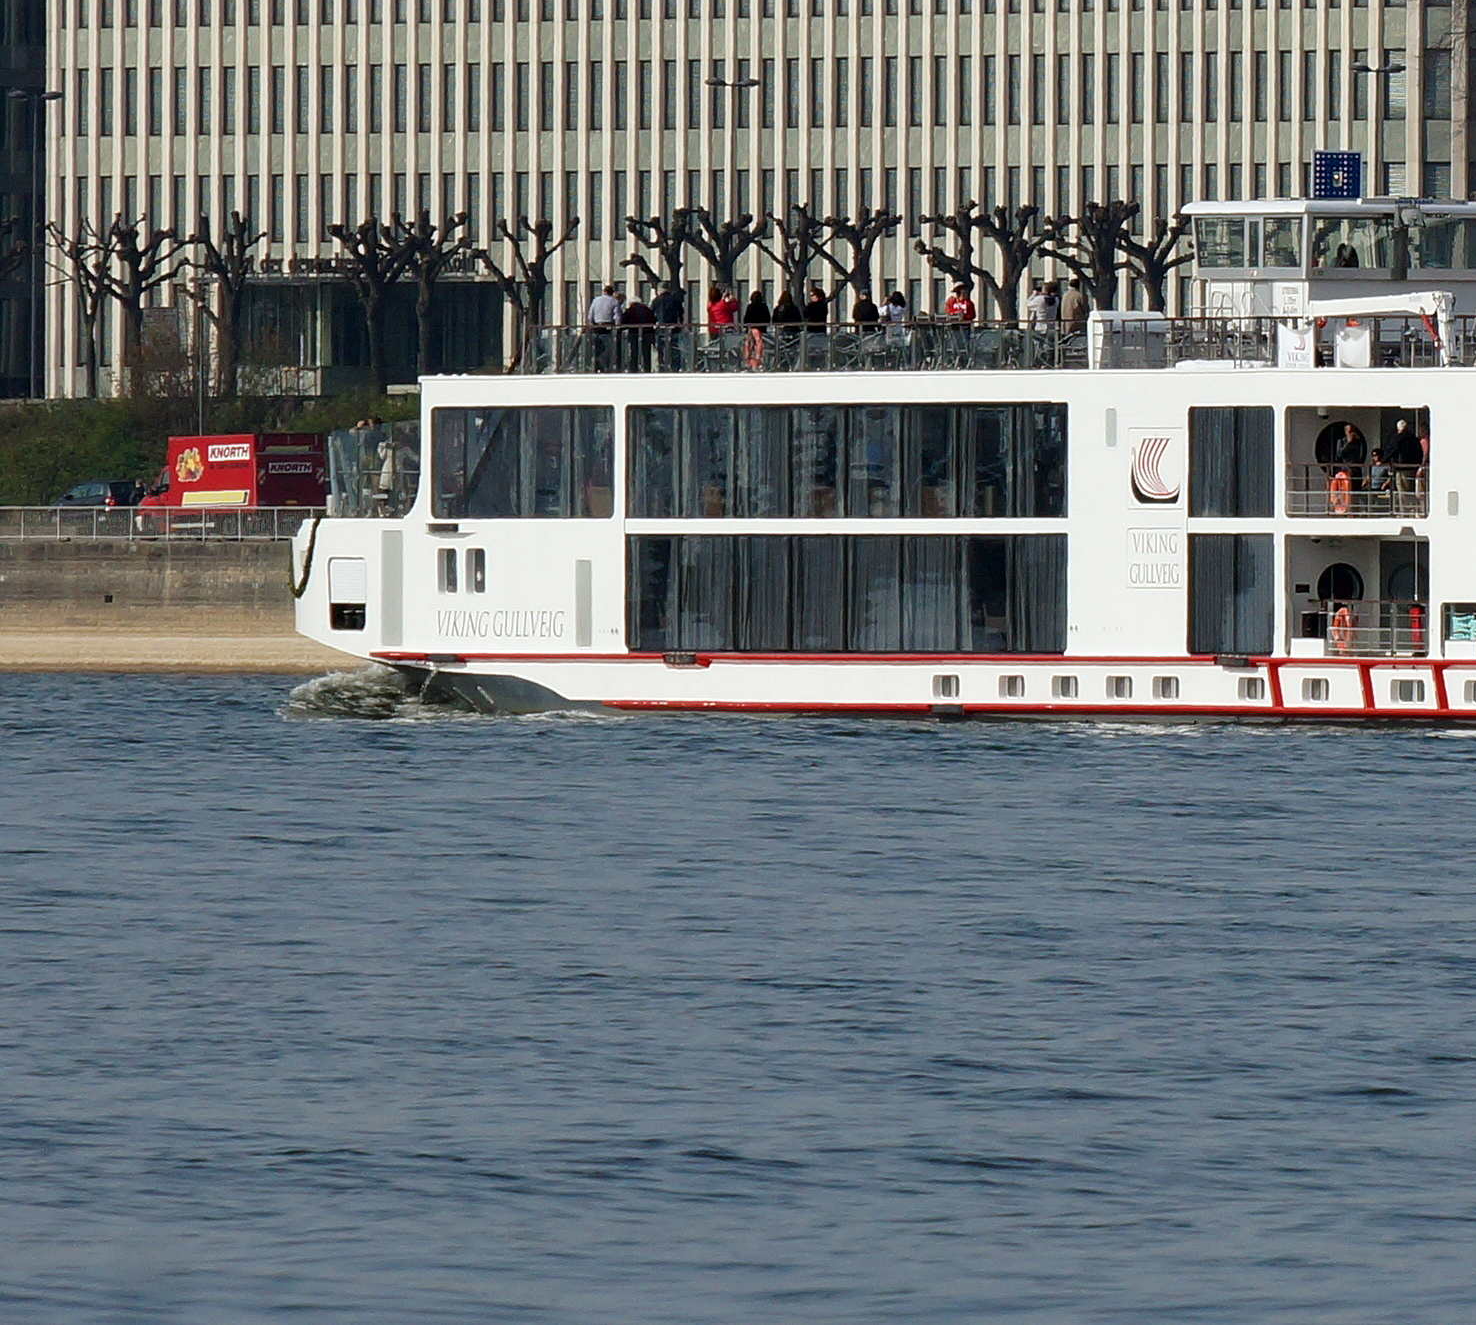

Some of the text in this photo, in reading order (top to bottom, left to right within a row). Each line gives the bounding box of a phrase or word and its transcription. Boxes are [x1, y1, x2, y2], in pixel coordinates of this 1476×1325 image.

[210, 446, 250, 459] KNORTH
[270, 463, 312, 472] KNORTH
[1132, 533, 1178, 554] VIKING
[1129, 563, 1180, 584] GULLVEIG
[437, 610, 565, 638] VIKING GULLVEIG
